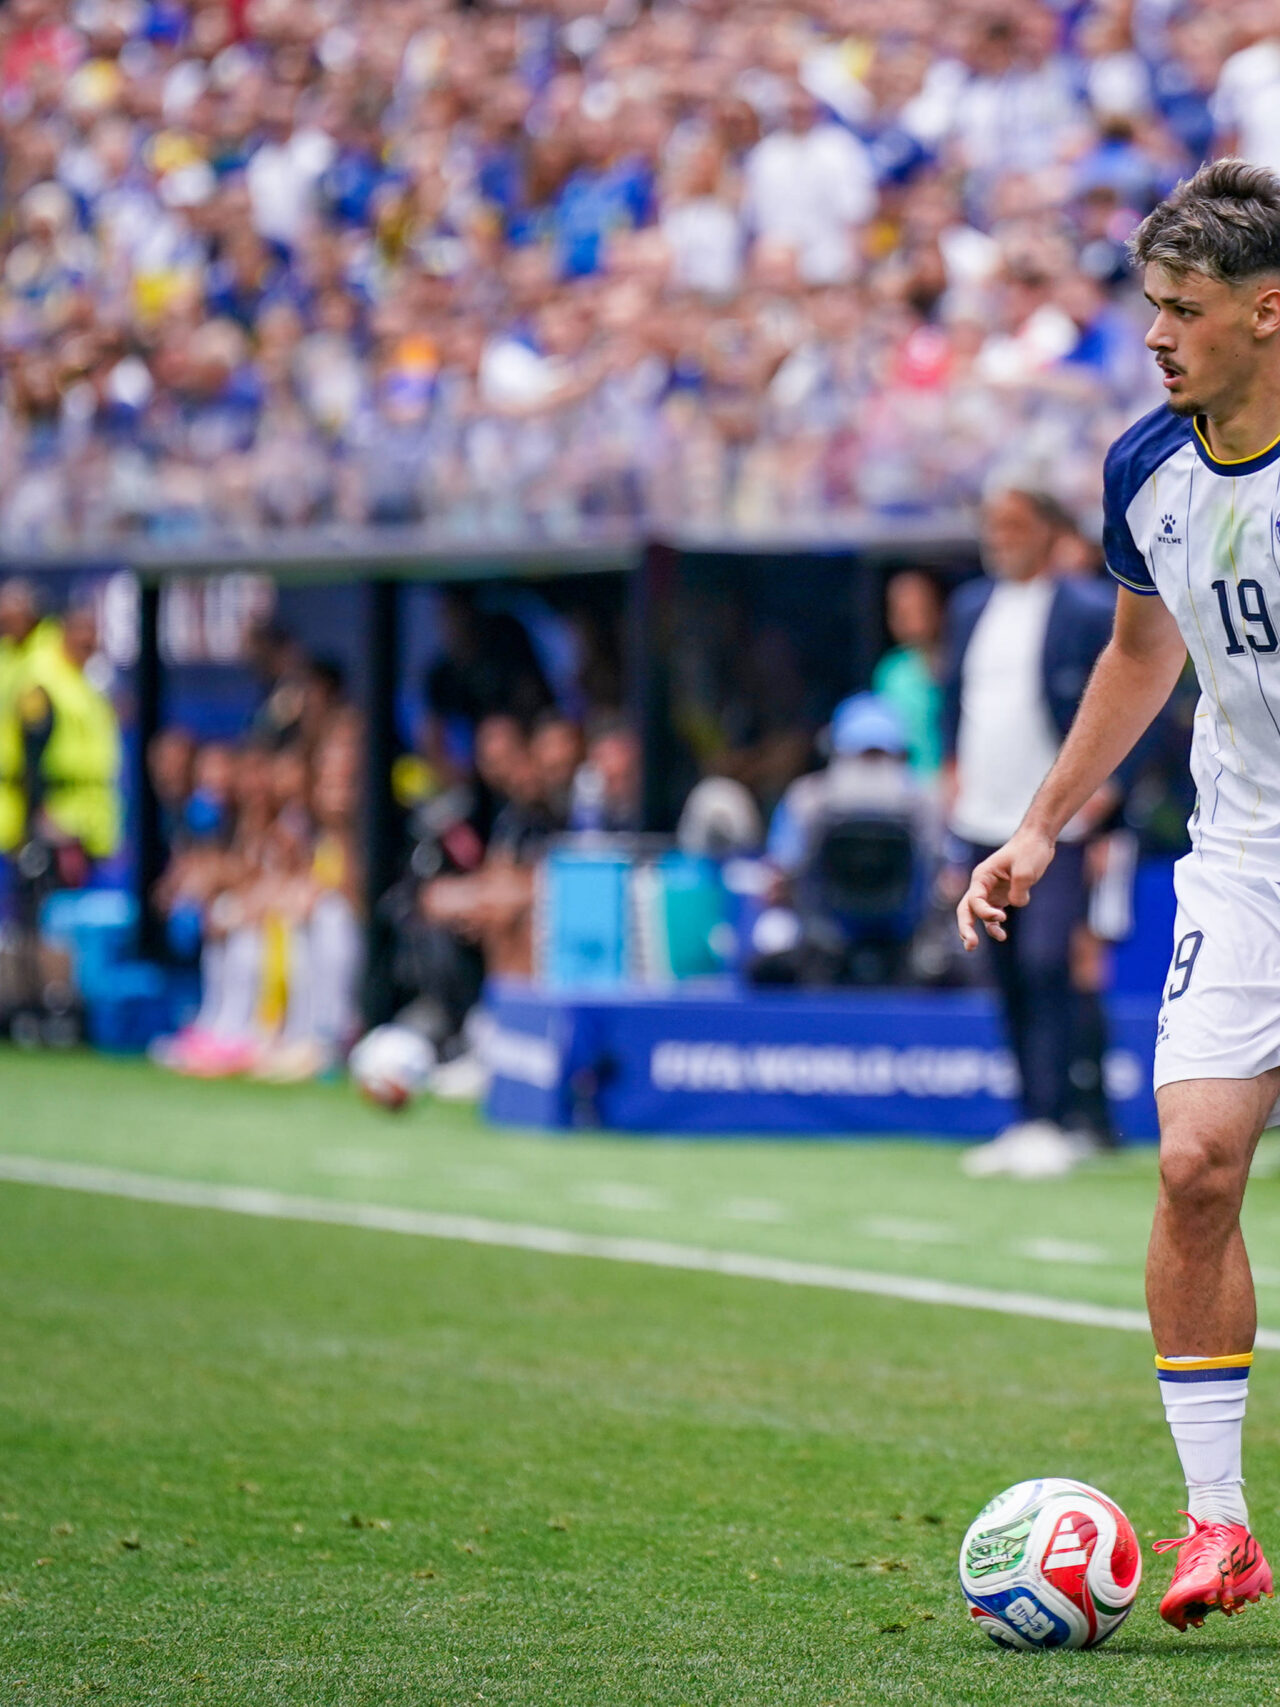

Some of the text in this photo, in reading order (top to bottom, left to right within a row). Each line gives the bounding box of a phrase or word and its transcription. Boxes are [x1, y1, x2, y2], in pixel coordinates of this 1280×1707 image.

[1157, 536, 1182, 545] KELME
[1211, 579, 1280, 657] 19
[1161, 930, 1204, 1008] 9
